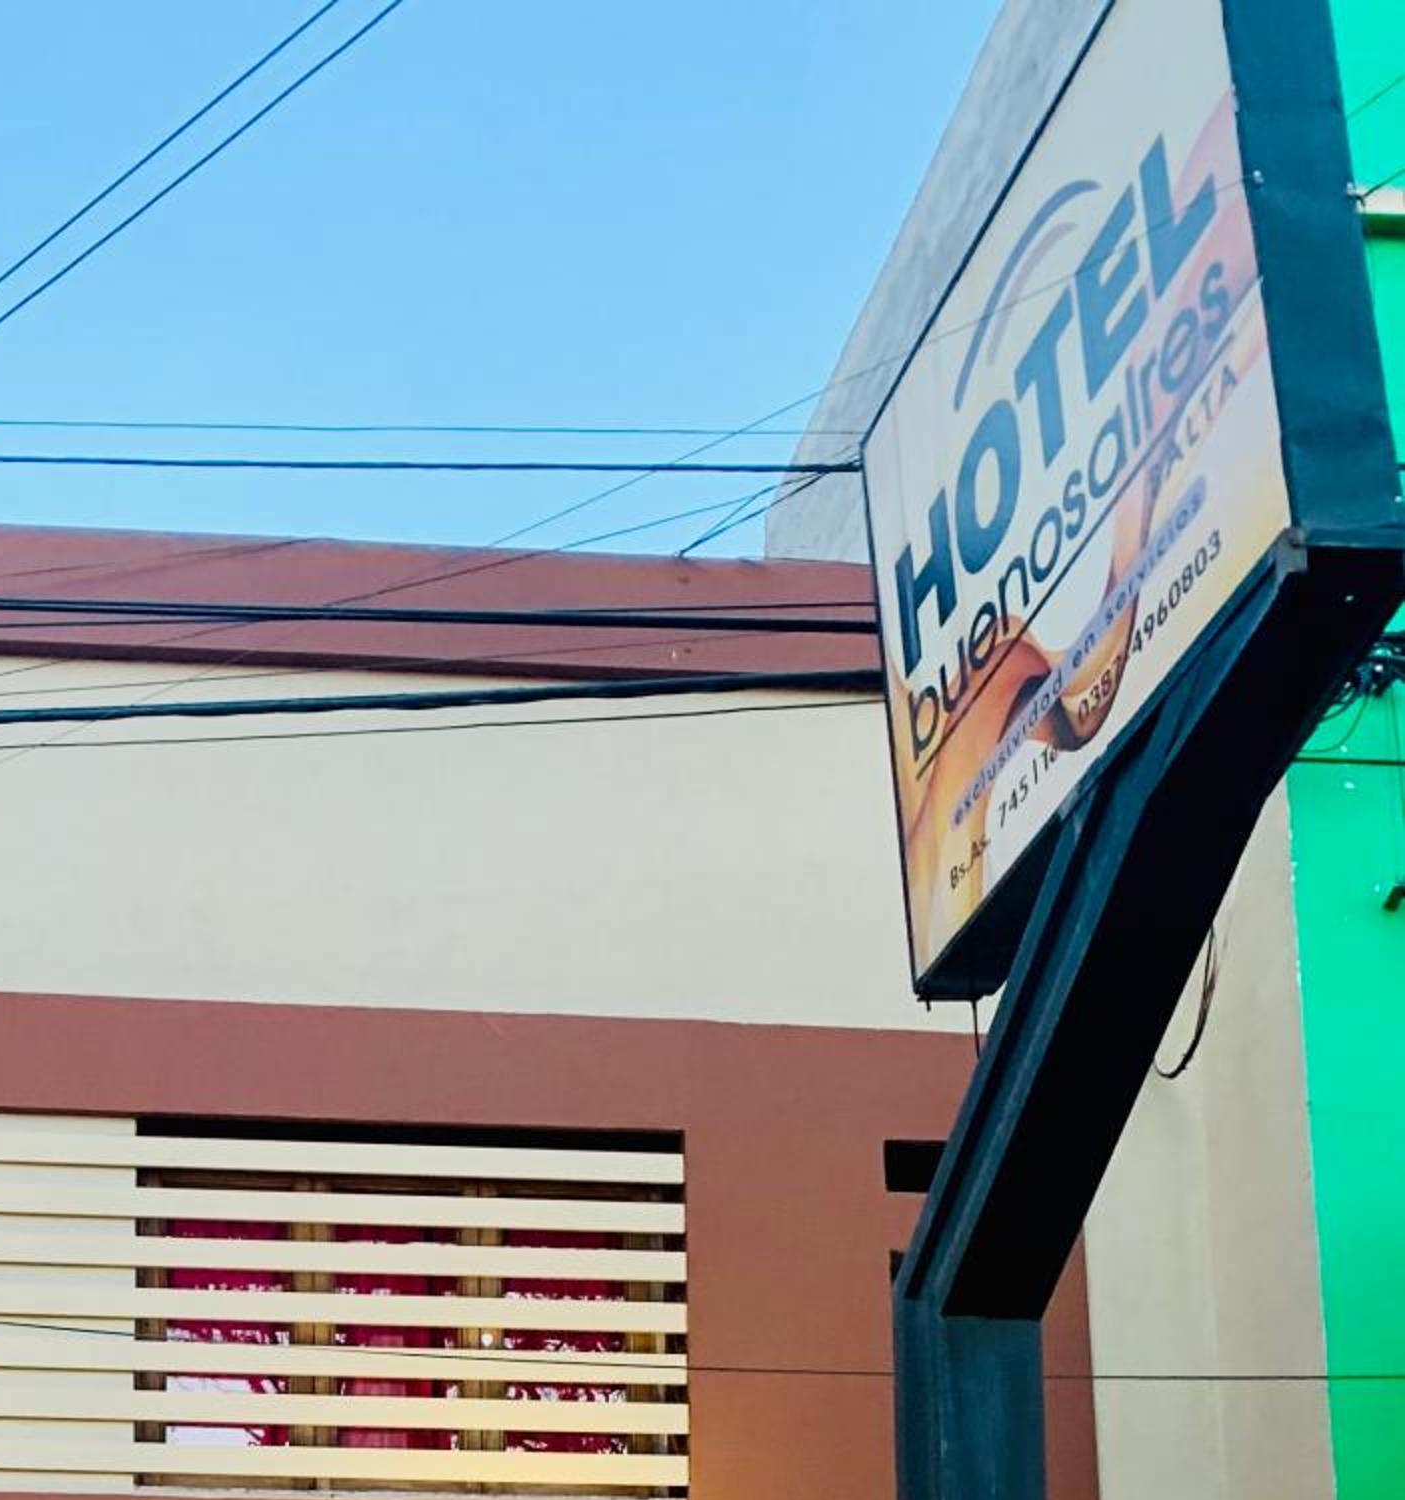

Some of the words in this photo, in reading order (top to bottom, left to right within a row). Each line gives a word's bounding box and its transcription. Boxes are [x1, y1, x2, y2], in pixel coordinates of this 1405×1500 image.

[894, 132, 1217, 679] HOTEL
[1072, 631, 1097, 669] en
[999, 772, 1029, 828] 745
